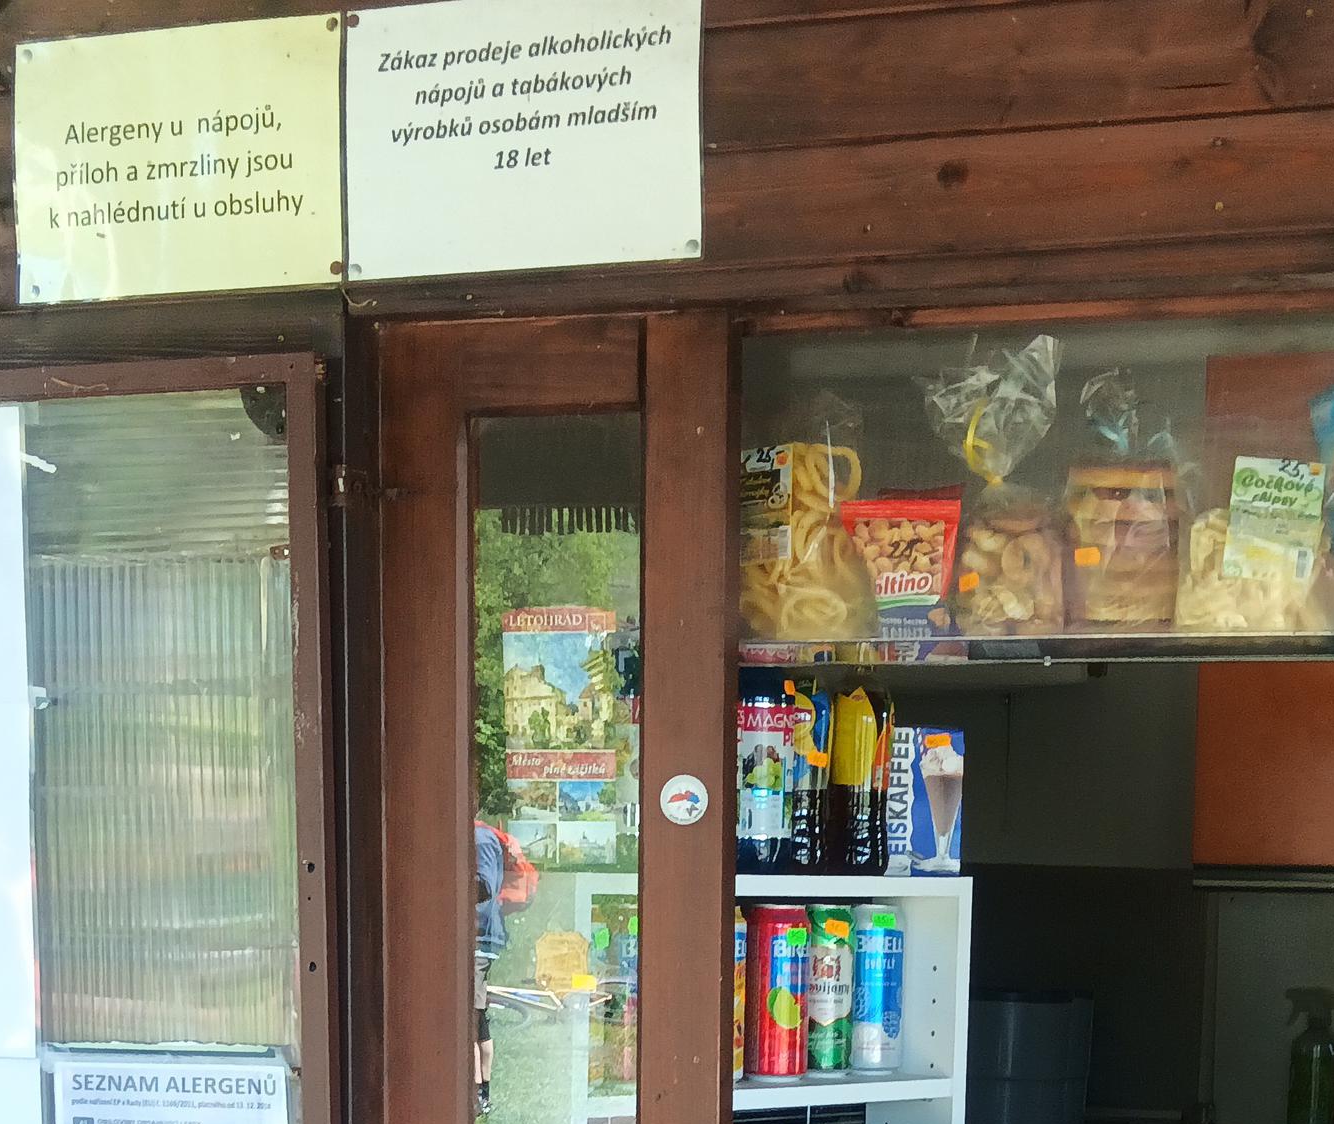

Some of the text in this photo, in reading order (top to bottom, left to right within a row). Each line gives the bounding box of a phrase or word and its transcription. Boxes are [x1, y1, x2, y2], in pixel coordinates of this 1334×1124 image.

[377, 24, 672, 73] Zákaz prodeje alkoholických
[414, 66, 633, 106] nápojů a tabákových
[64, 104, 283, 147] Alergeny u nápojů,
[391, 99, 658, 146] výrobků osobám mladším
[55, 148, 294, 191] příloh a zmrzliny jsou
[495, 146, 551, 170] 18 let
[48, 189, 304, 229] k nahlédnutí u obsluhy
[509, 612, 583, 628] LETOHRAD
[888, 730, 910, 857] EISKAFFEE
[71, 1073, 276, 1096] SEZNAM ALERGENŮ
